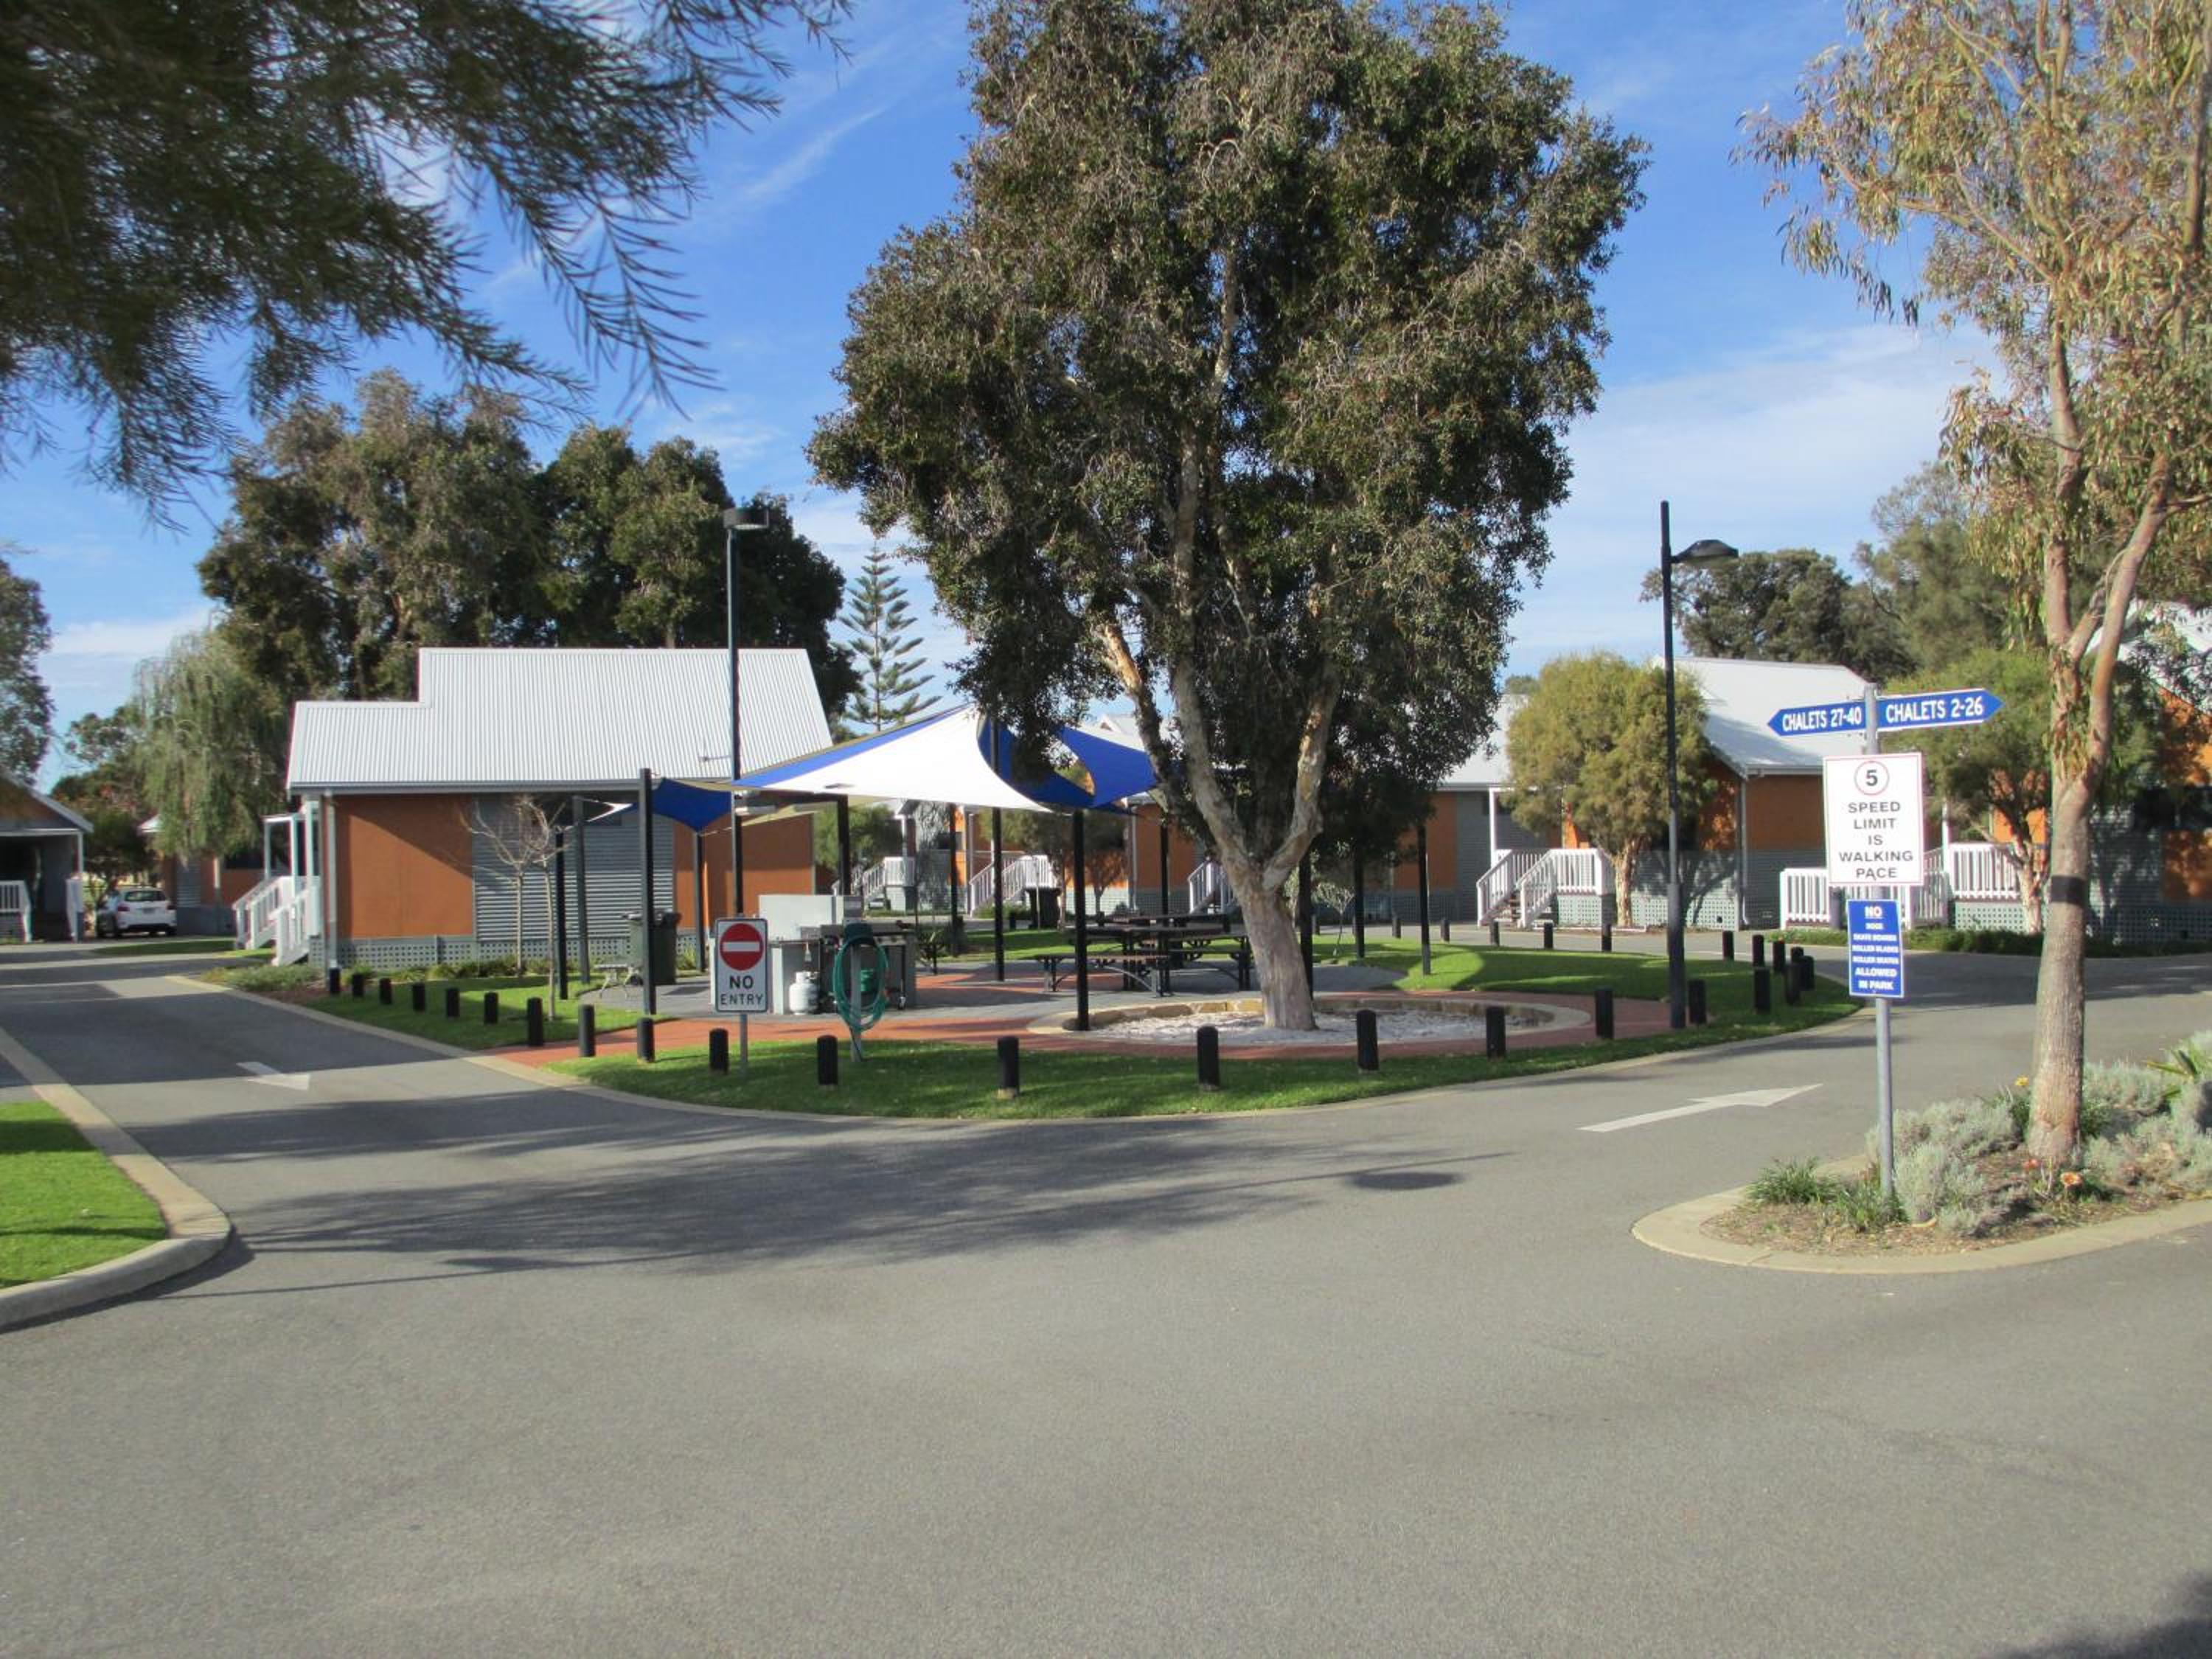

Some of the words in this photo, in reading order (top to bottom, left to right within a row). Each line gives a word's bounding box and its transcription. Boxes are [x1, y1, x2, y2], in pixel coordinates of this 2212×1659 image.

[1885, 700, 1946, 723] CHALETS
[1951, 695, 1983, 717] 2-26
[1782, 710, 1827, 731] CHALETS
[1830, 706, 1862, 728] 27-40
[1865, 769, 1878, 786] 5
[1848, 801, 1901, 813] SPEED
[1854, 818, 1896, 830] LIMIT
[1868, 835, 1883, 846] IS
[1839, 850, 1913, 862] WALKING
[1856, 867, 1897, 879] PACE
[1865, 905, 1882, 917] NO
[1855, 967, 1896, 977] ALLOWED
[729, 975, 754, 989] NO
[1870, 980, 1894, 990] PARK
[720, 993, 763, 1005] ENTRY
